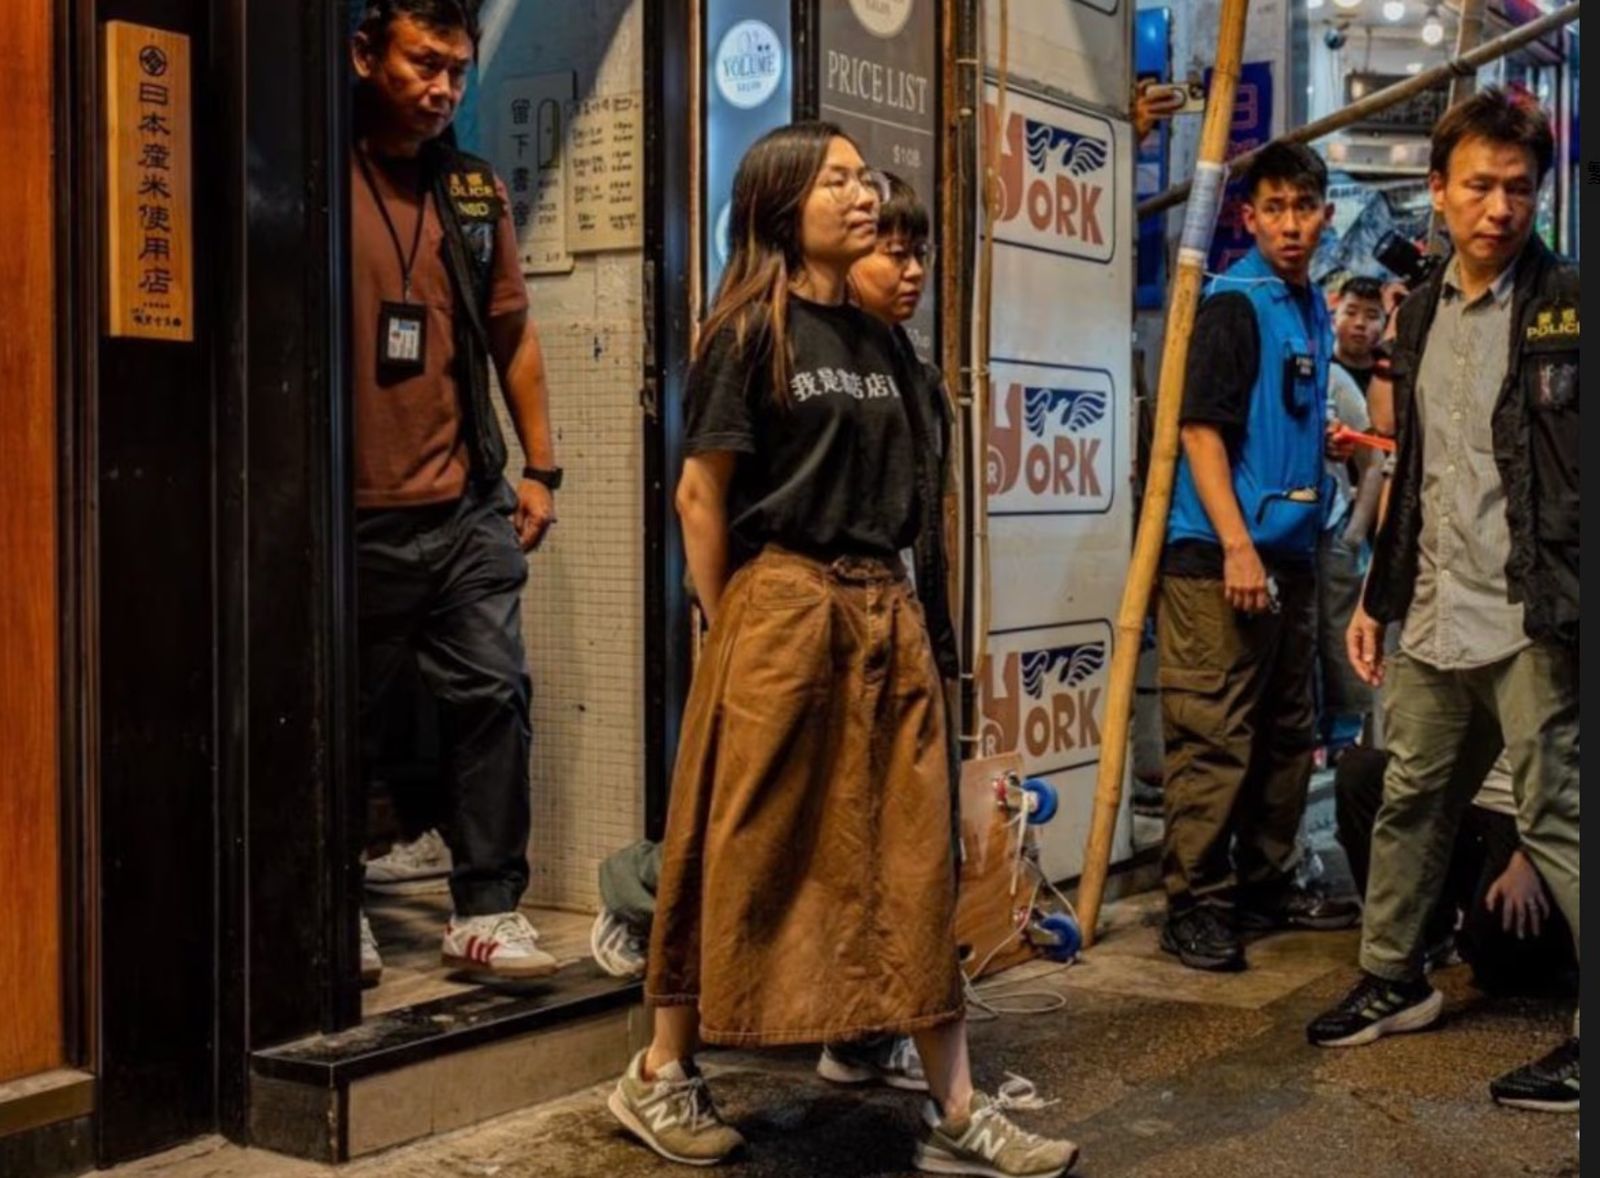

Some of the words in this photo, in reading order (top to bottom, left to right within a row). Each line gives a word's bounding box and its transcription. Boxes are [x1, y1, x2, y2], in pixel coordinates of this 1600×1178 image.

[722, 54, 775, 77] VOLUME
[828, 50, 883, 103] PRICE
[887, 67, 927, 114] LIST
[449, 185, 494, 198] OLICE
